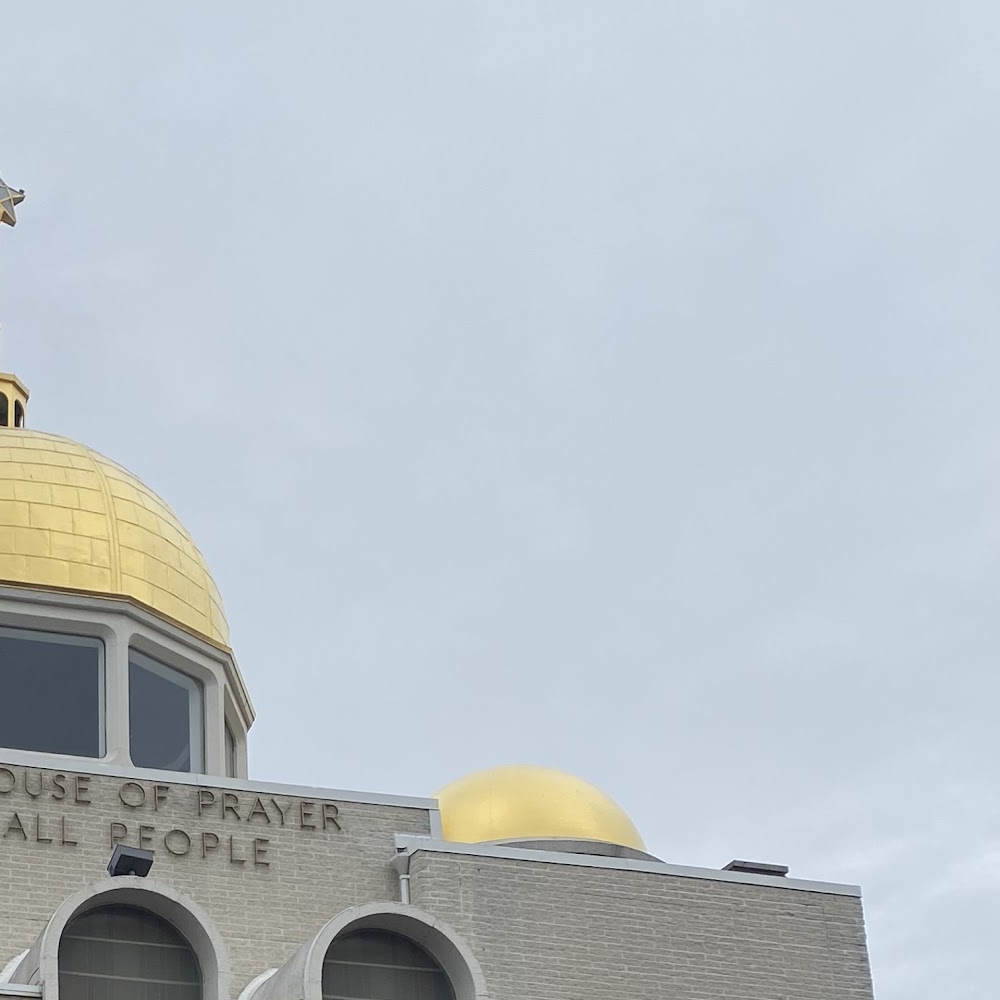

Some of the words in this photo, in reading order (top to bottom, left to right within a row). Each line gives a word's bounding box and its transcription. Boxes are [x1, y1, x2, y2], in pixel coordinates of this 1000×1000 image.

[118, 781, 170, 812] OF
[198, 789, 341, 831] PRAYER
[3, 812, 78, 846] ALL
[110, 822, 270, 866] PEOPLE
